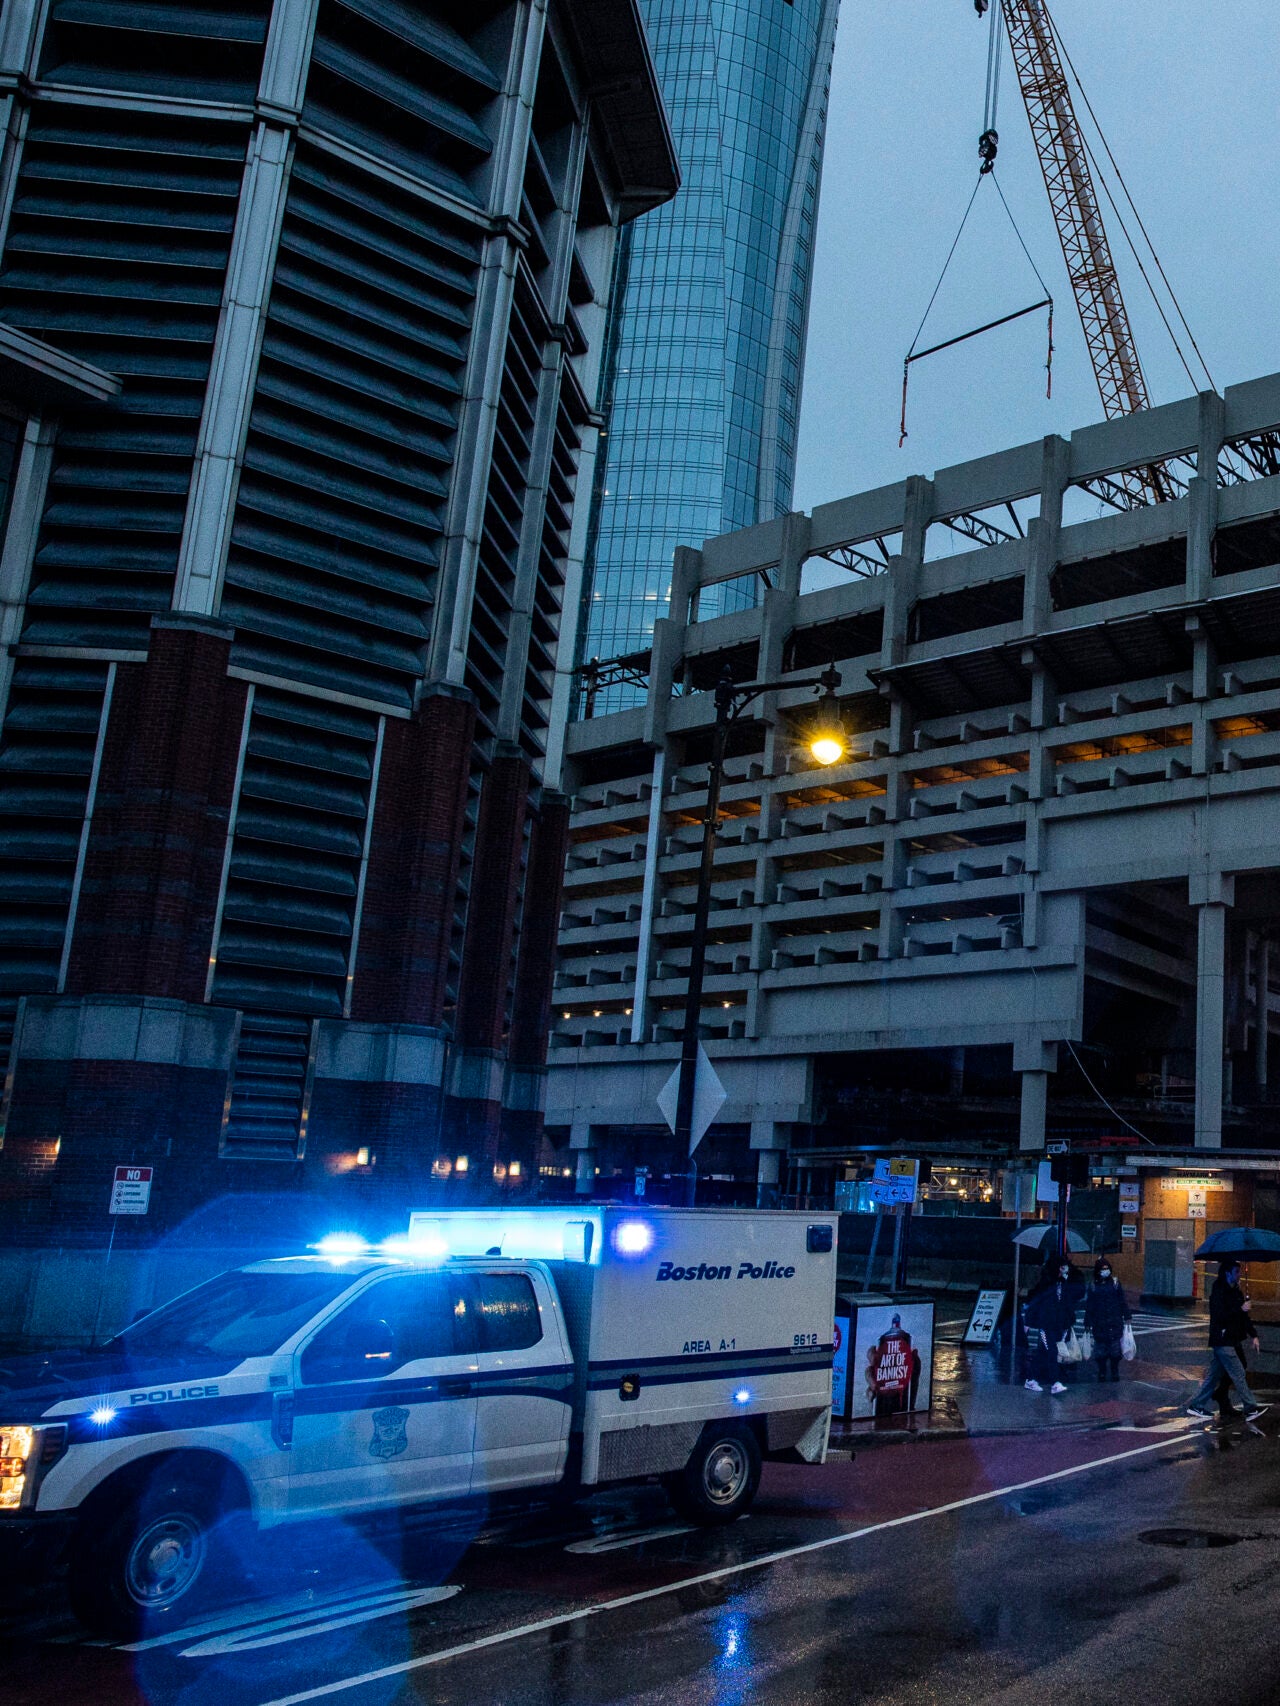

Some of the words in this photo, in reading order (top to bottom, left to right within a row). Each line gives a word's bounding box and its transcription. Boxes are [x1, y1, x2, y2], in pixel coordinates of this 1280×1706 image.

[126, 1169, 141, 1181] NO
[656, 1261, 732, 1281] Boston
[736, 1261, 796, 1279] Police
[682, 1340, 711, 1354] AREA
[719, 1338, 736, 1351] A-1
[793, 1333, 818, 1346] 9612
[886, 1340, 902, 1354] THE
[880, 1354, 895, 1368] ART
[896, 1353, 907, 1366] OF
[876, 1366, 909, 1382] BANKSY
[130, 1385, 220, 1405] POLICE
